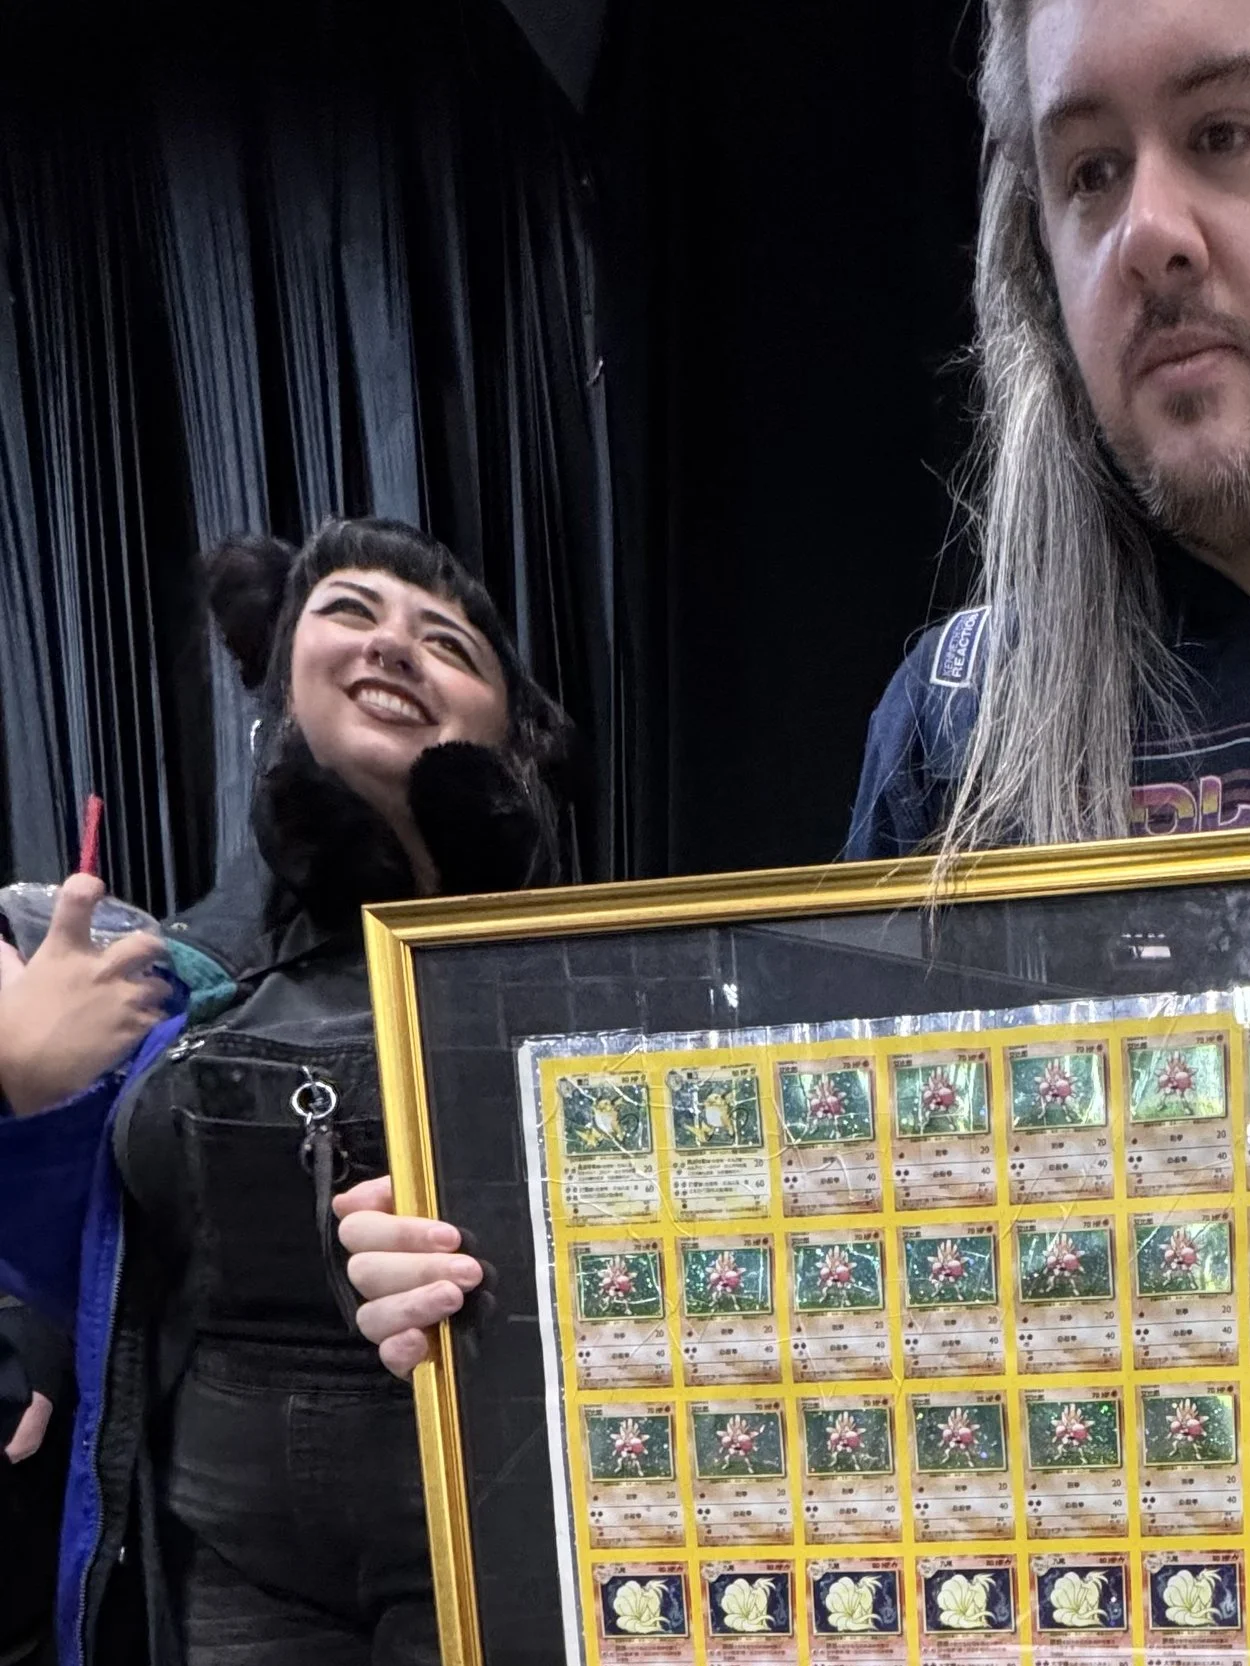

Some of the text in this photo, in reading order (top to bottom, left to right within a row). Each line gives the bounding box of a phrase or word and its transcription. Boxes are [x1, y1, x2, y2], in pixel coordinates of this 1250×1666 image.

[1216, 1130, 1226, 1138] 20
[1097, 1138, 1106, 1146] 20
[980, 1145, 989, 1153] 20
[865, 1152, 874, 1160] 20
[1097, 1159, 1107, 1167] 40
[980, 1166, 990, 1174] 40
[866, 1173, 876, 1181] 40
[1221, 1305, 1231, 1313] 20
[1104, 1311, 1114, 1319] 20
[655, 1329, 664, 1337] 20
[763, 1325, 773, 1333] 20
[1222, 1326, 1232, 1334] 40
[988, 1336, 998, 1344] 40
[764, 1345, 773, 1353] 40
[1226, 1475, 1236, 1483] 20
[884, 1485, 894, 1493] 20
[997, 1482, 1007, 1490] 20
[776, 1488, 786, 1496] 20
